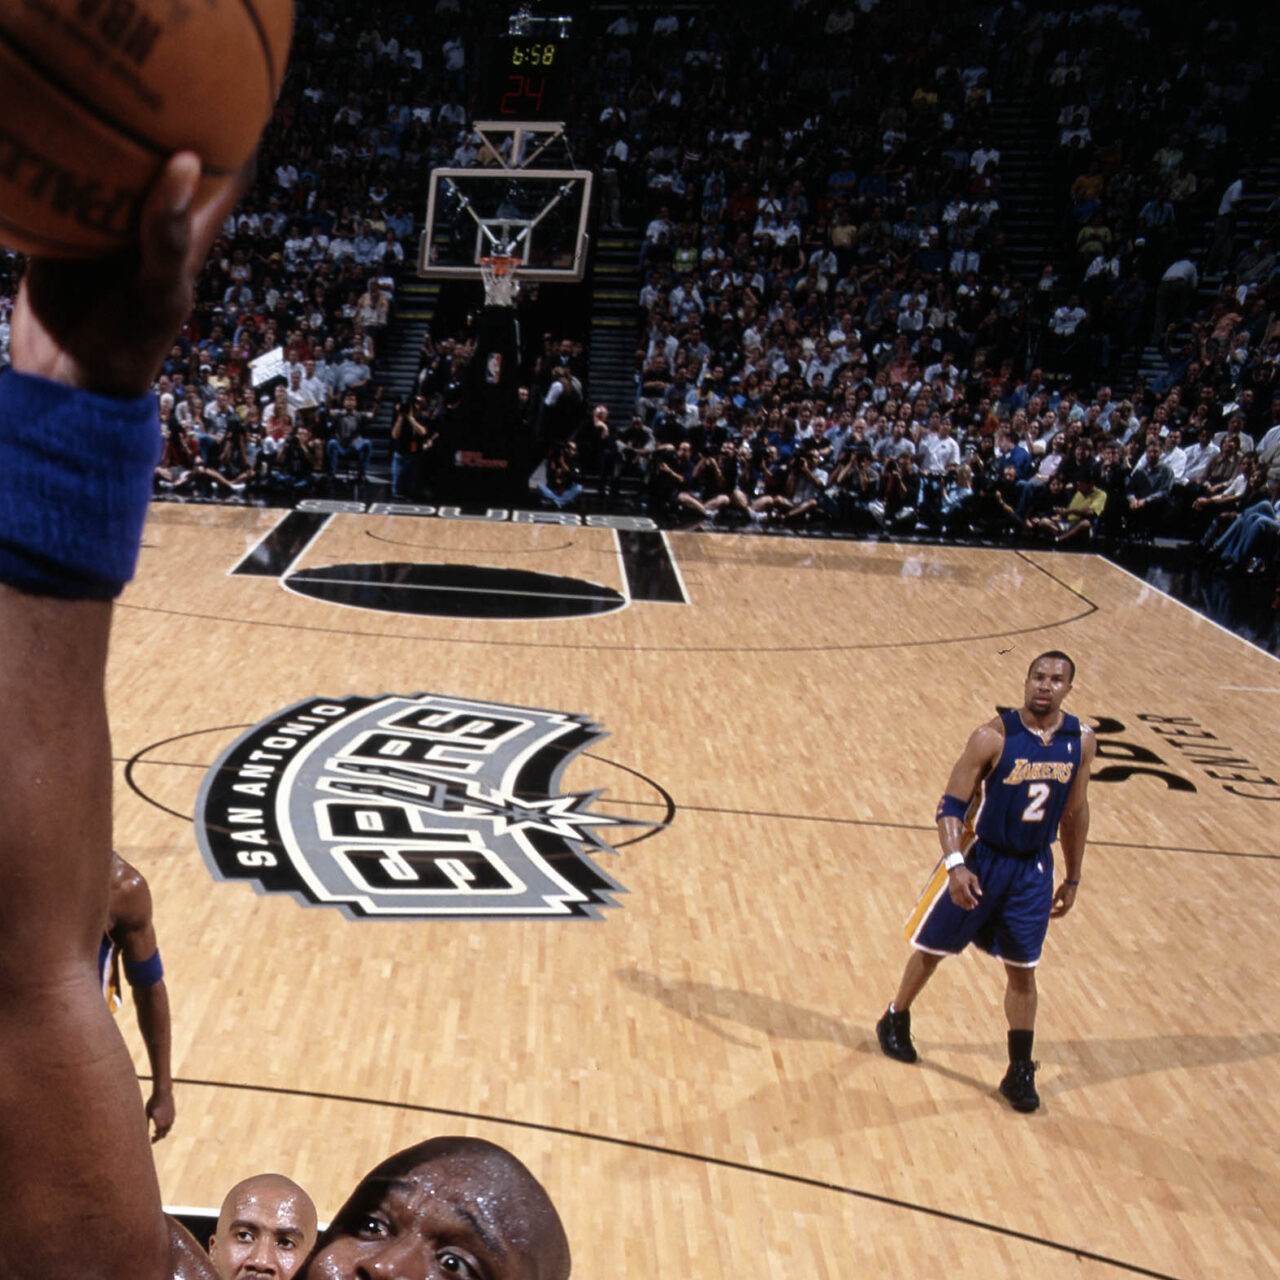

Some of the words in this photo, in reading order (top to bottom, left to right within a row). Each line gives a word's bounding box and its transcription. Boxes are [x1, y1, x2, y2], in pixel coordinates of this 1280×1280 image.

[512, 44, 555, 65] 6:58
[500, 75, 546, 114] 24
[295, 500, 659, 531] SPURS
[231, 703, 348, 798] ANTONIO
[1003, 758, 1073, 785] LAKERS
[314, 702, 538, 897] SPURS
[1021, 782, 1051, 822] 2
[230, 806, 280, 868] SAN
